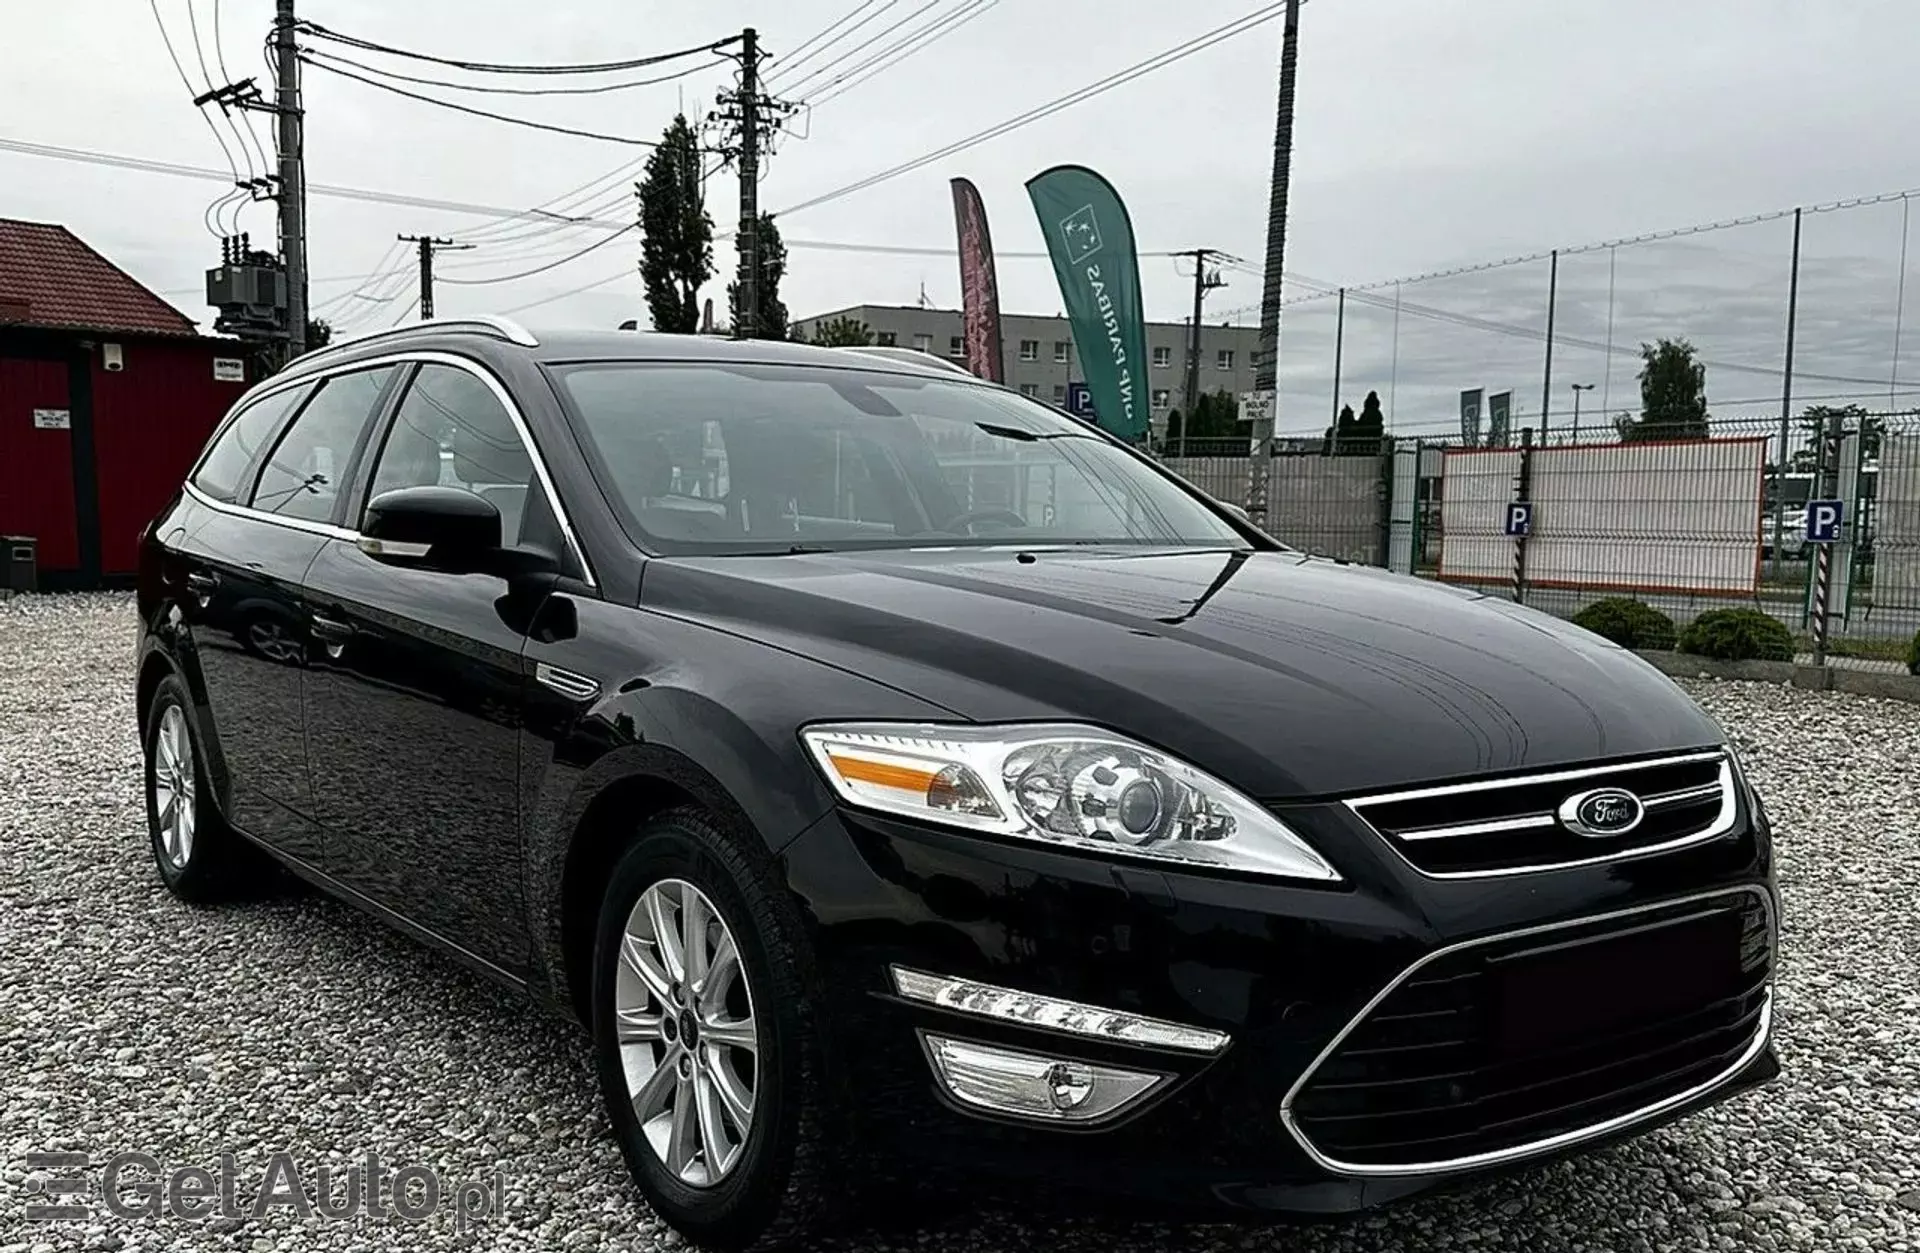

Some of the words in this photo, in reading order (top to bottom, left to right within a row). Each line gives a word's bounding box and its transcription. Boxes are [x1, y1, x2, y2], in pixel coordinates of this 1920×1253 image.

[1078, 391, 1090, 409] P
[1511, 508, 1527, 531] P
[1815, 506, 1836, 536] P
[1594, 797, 1629, 823] Ford
